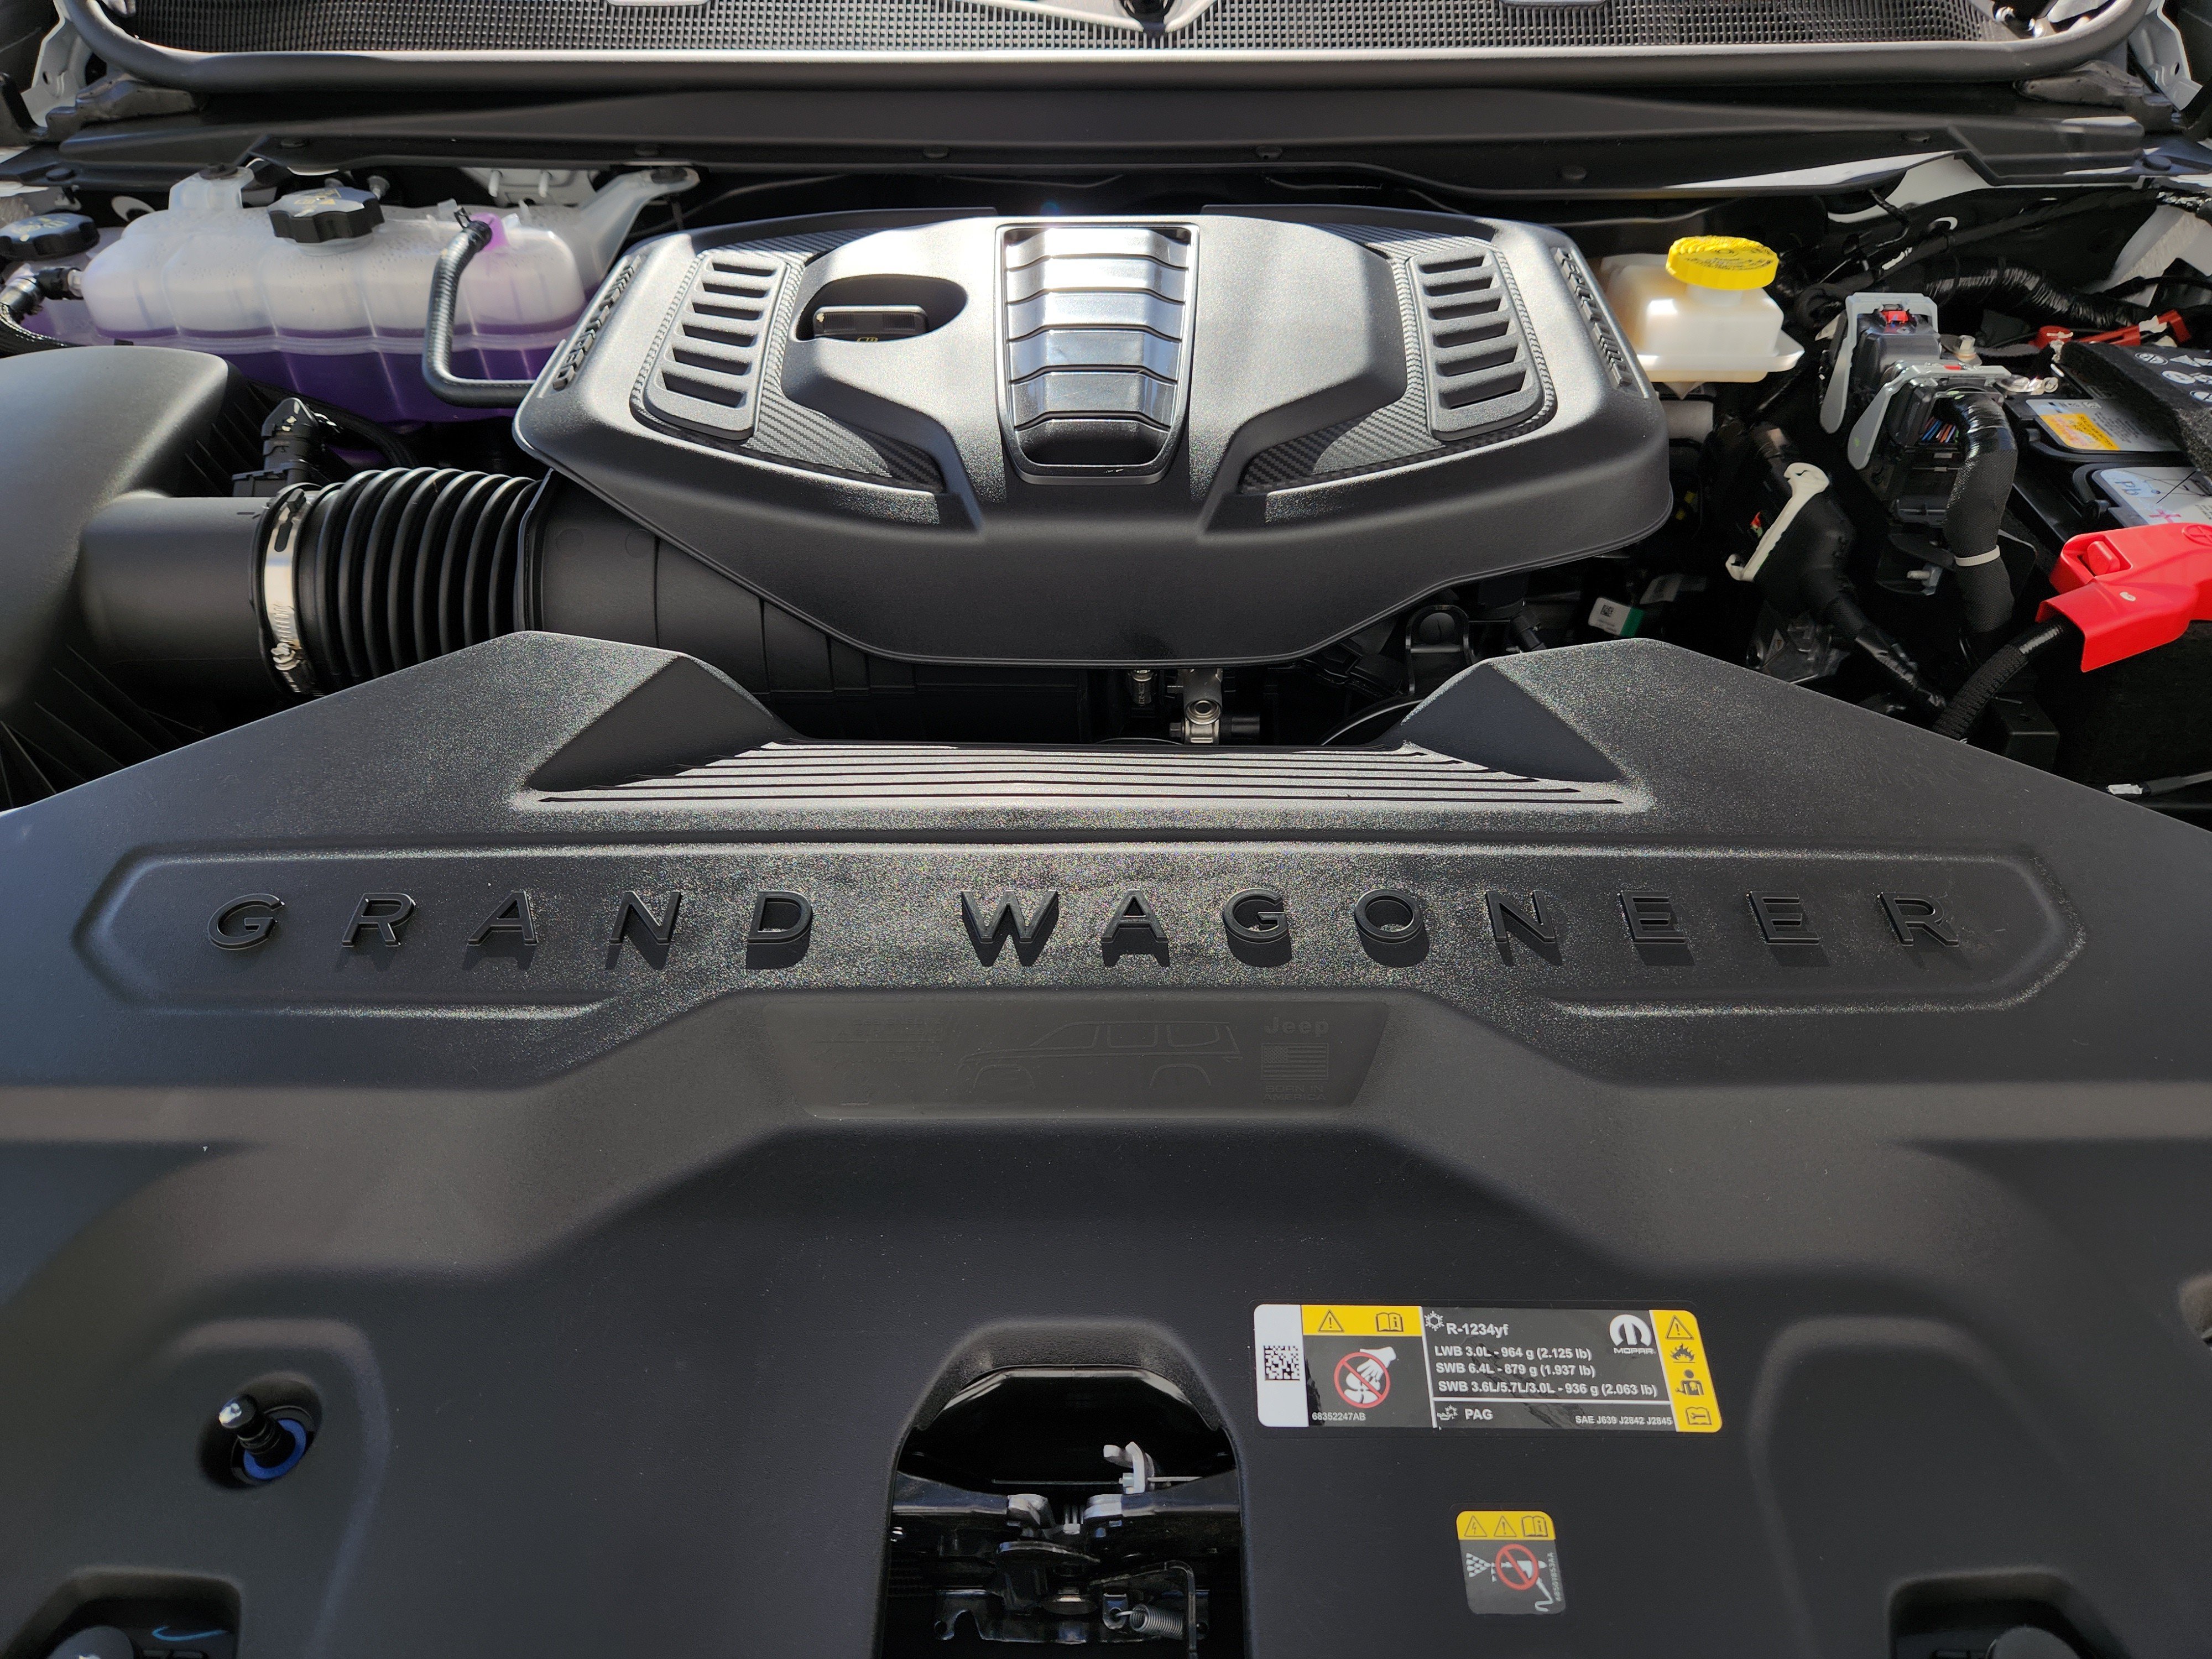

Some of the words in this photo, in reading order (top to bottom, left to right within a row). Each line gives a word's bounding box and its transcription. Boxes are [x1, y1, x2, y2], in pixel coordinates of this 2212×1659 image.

[208, 890, 812, 950] GRAND
[959, 890, 1959, 947] WAGONEER
[1264, 1017, 1329, 1037] Jeep
[1446, 1322, 1509, 1338] R-1234yf
[1434, 1345, 1463, 1357] LWB
[1465, 1346, 1492, 1358] 3.0L
[1501, 1347, 1523, 1359] 964
[1526, 1350, 1535, 1360] g
[1537, 1348, 1573, 1360] (2.125
[1575, 1348, 1593, 1361] lb)
[1436, 1364, 1465, 1374] SWB
[1468, 1364, 1494, 1375] 6.4L
[1505, 1365, 1526, 1375] 879
[1529, 1368, 1537, 1377] g
[1540, 1365, 1576, 1377] (1.937
[1579, 1365, 1596, 1378] lb)
[1438, 1381, 1468, 1392] SWB
[1471, 1381, 1556, 1394] 3.6L/5.7L/3.0L
[1565, 1384, 1587, 1394] 936
[1590, 1386, 1599, 1396] g
[1601, 1384, 1638, 1397] (2.063
[1641, 1384, 1658, 1397] lb)
[1312, 1412, 1366, 1421] 68352247AB
[1464, 1409, 1493, 1420] PAG
[1575, 1416, 1595, 1425] SAE
[1597, 1416, 1616, 1425] J639
[1619, 1416, 1645, 1425] J2842
[1646, 1416, 1672, 1426] J2845
